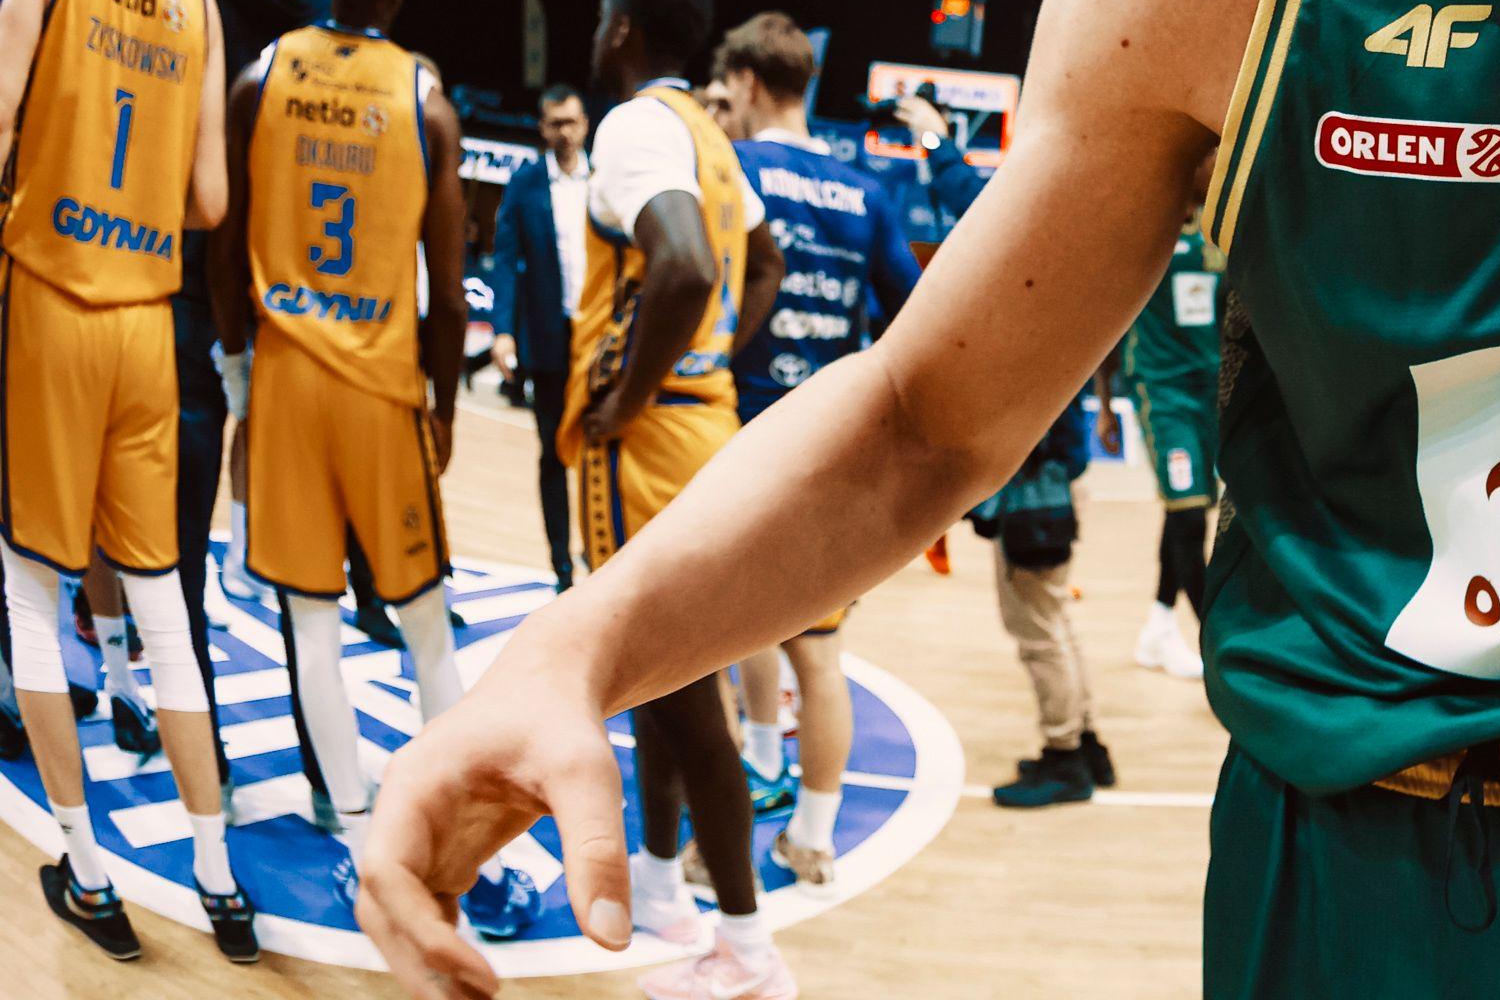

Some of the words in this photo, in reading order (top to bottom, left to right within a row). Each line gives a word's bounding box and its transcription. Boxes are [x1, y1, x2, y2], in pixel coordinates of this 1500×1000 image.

[1364, 3, 1493, 69] 4F
[110, 87, 136, 190] 1
[285, 96, 356, 127] netia
[1330, 126, 1446, 166] ORLEN
[52, 197, 174, 263] GDYNIA
[309, 181, 356, 277] 3
